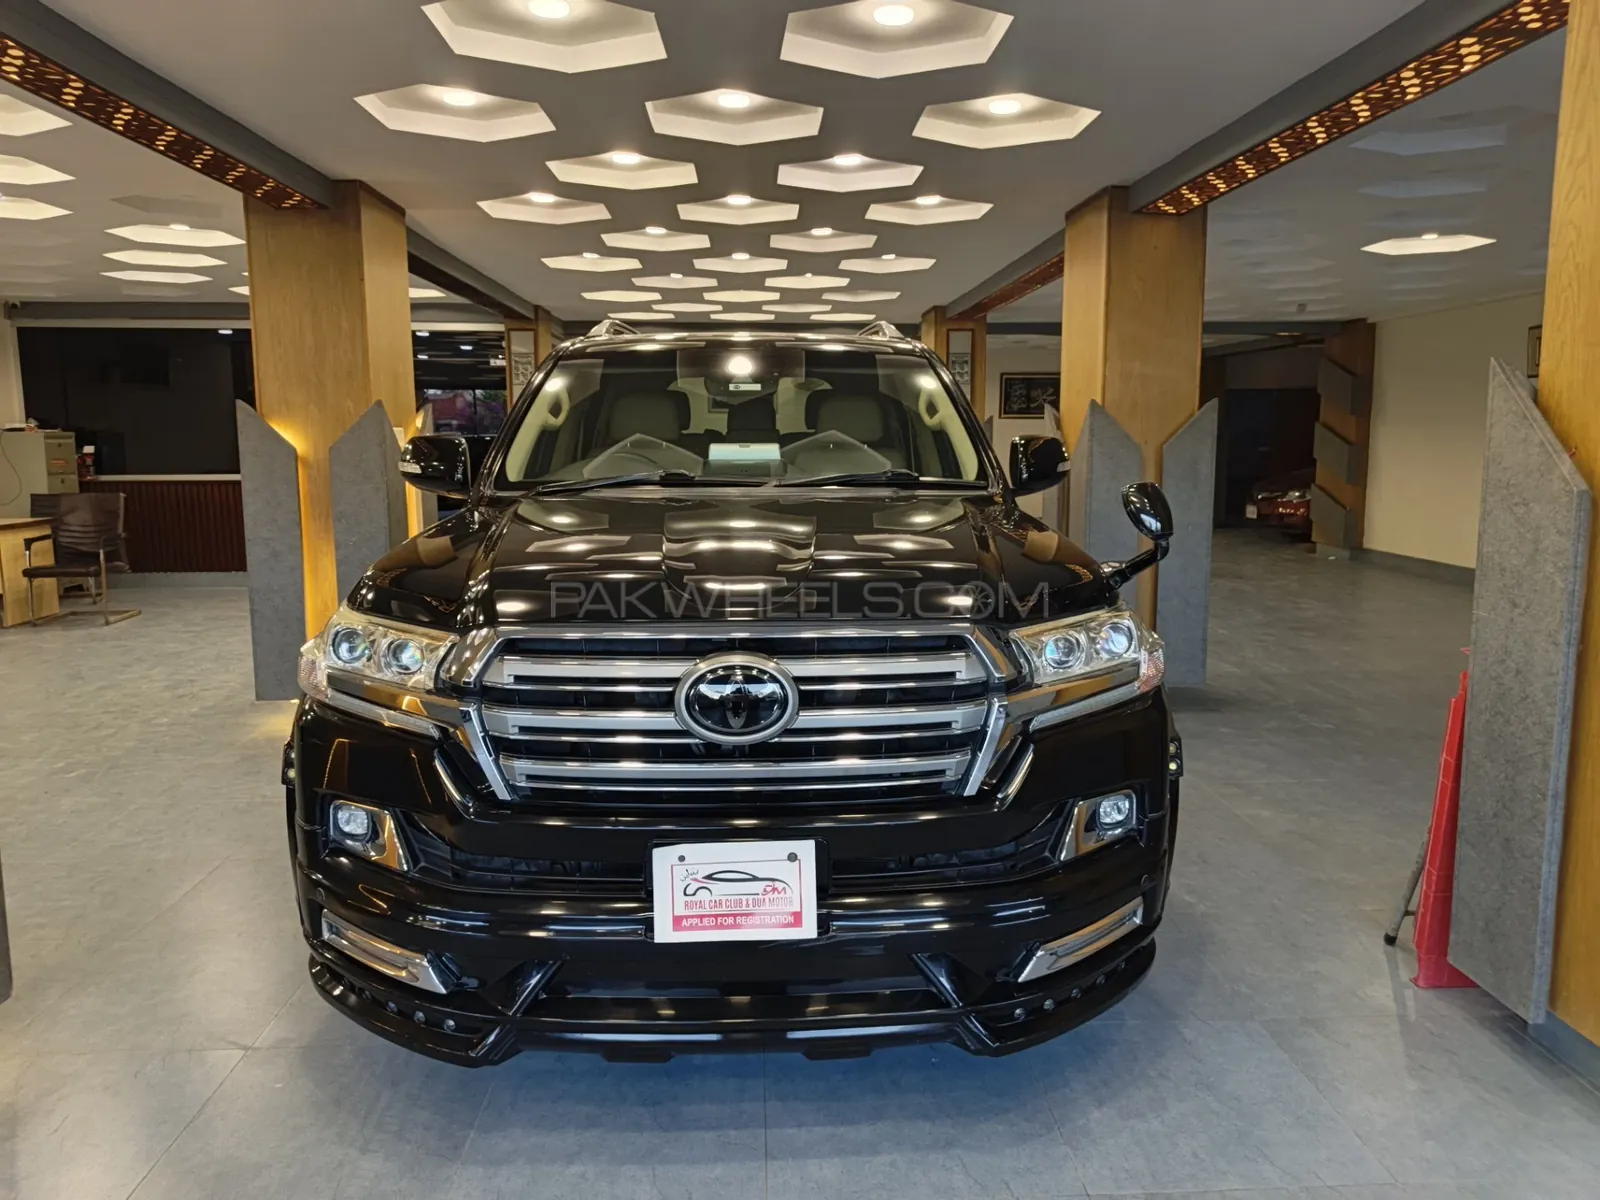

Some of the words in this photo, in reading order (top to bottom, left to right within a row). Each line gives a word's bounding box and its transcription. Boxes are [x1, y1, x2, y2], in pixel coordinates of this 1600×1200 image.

[684, 900, 707, 911] ROYAL
[708, 899, 723, 910] CAR
[724, 898, 744, 909] CLUB
[745, 898, 750, 909] &
[751, 897, 767, 908] DUA
[768, 896, 793, 908] MOTOR
[681, 917, 716, 927] APPLIED
[717, 916, 734, 926] FOR
[735, 914, 795, 925] REGISTRATION
